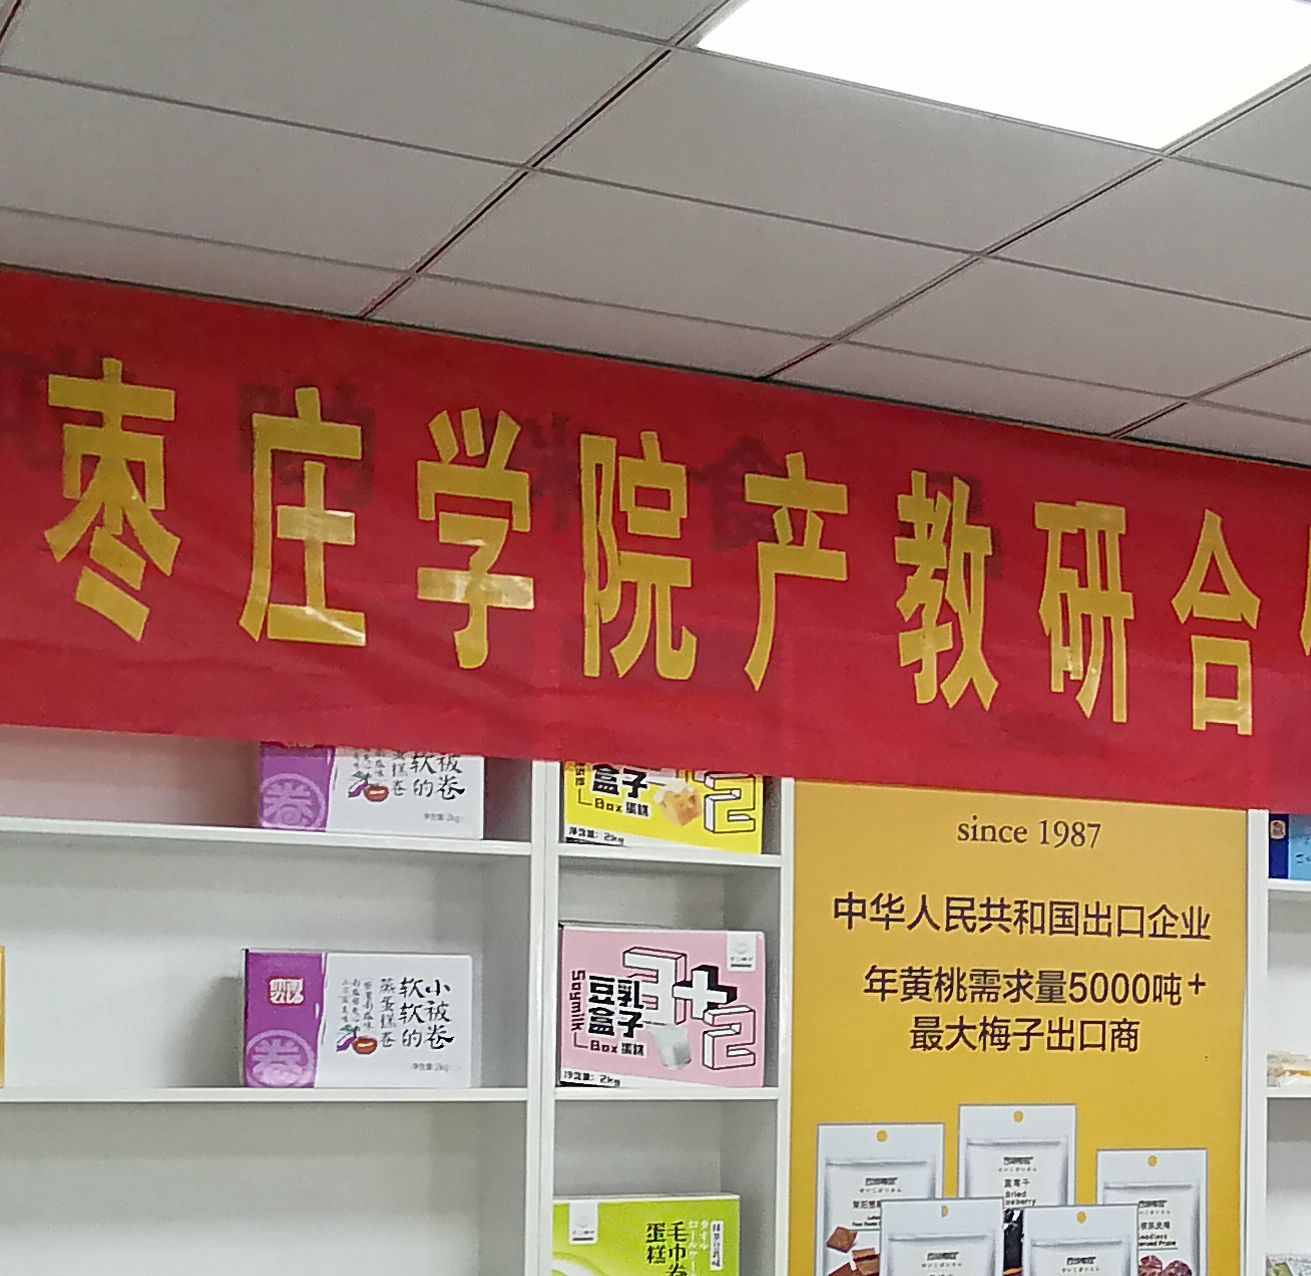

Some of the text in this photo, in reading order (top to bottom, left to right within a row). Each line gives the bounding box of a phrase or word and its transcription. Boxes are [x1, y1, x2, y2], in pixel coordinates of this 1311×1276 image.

[592, 763, 648, 798] 盒子
[594, 797, 622, 813] Box
[956, 814, 1102, 849] since 1987
[833, 892, 1212, 941] 中华人民共和国出口企业
[569, 969, 586, 1031] Soymilk
[588, 975, 644, 1008] 豆乳
[863, 964, 1208, 1006] 年黄桃需求量5000吨+
[399, 976, 425, 1049] 软软的
[426, 978, 455, 1050] 小被卷
[588, 1006, 644, 1038] 盒子
[590, 1040, 618, 1054] Box
[909, 1016, 1141, 1053] 最大梅子出口商
[646, 1221, 666, 1265] 蛋糕
